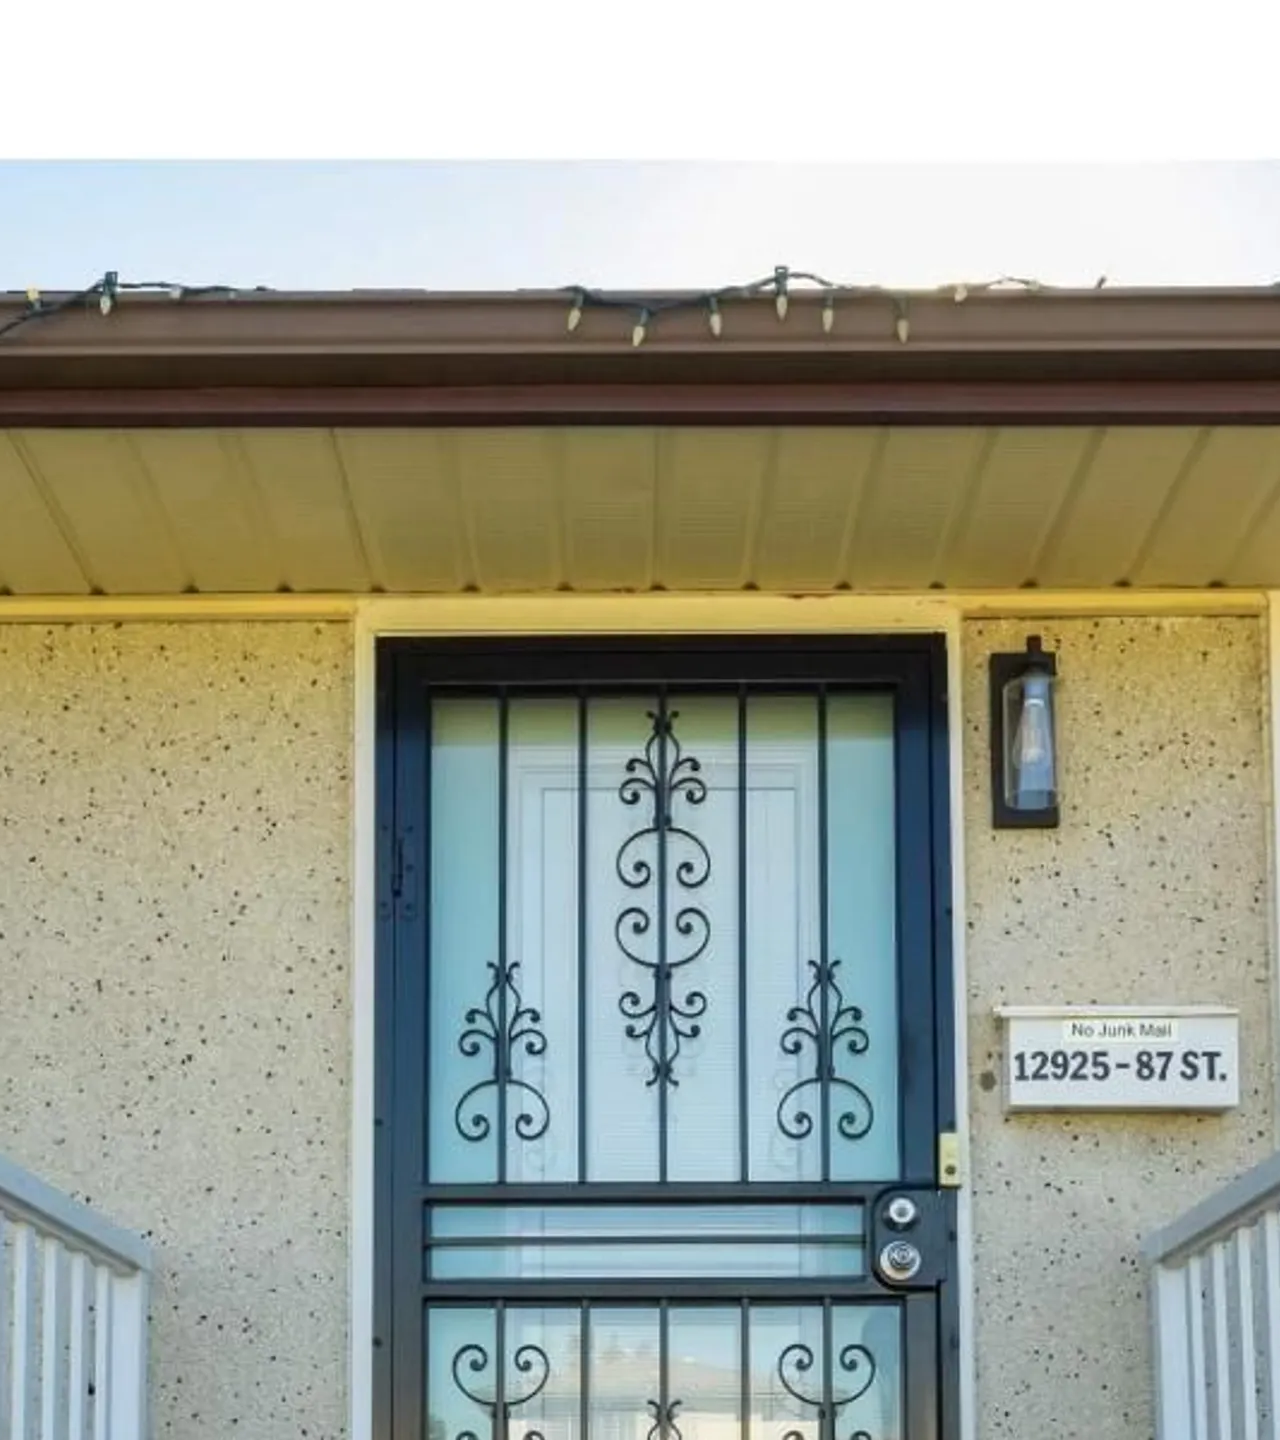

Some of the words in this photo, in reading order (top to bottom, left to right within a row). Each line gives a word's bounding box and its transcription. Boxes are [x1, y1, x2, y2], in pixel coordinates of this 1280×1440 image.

[1071, 1022, 1095, 1038] No
[1098, 1022, 1136, 1038] Junk
[1139, 1022, 1172, 1038] Mail
[1180, 1051, 1227, 1082] ST.
